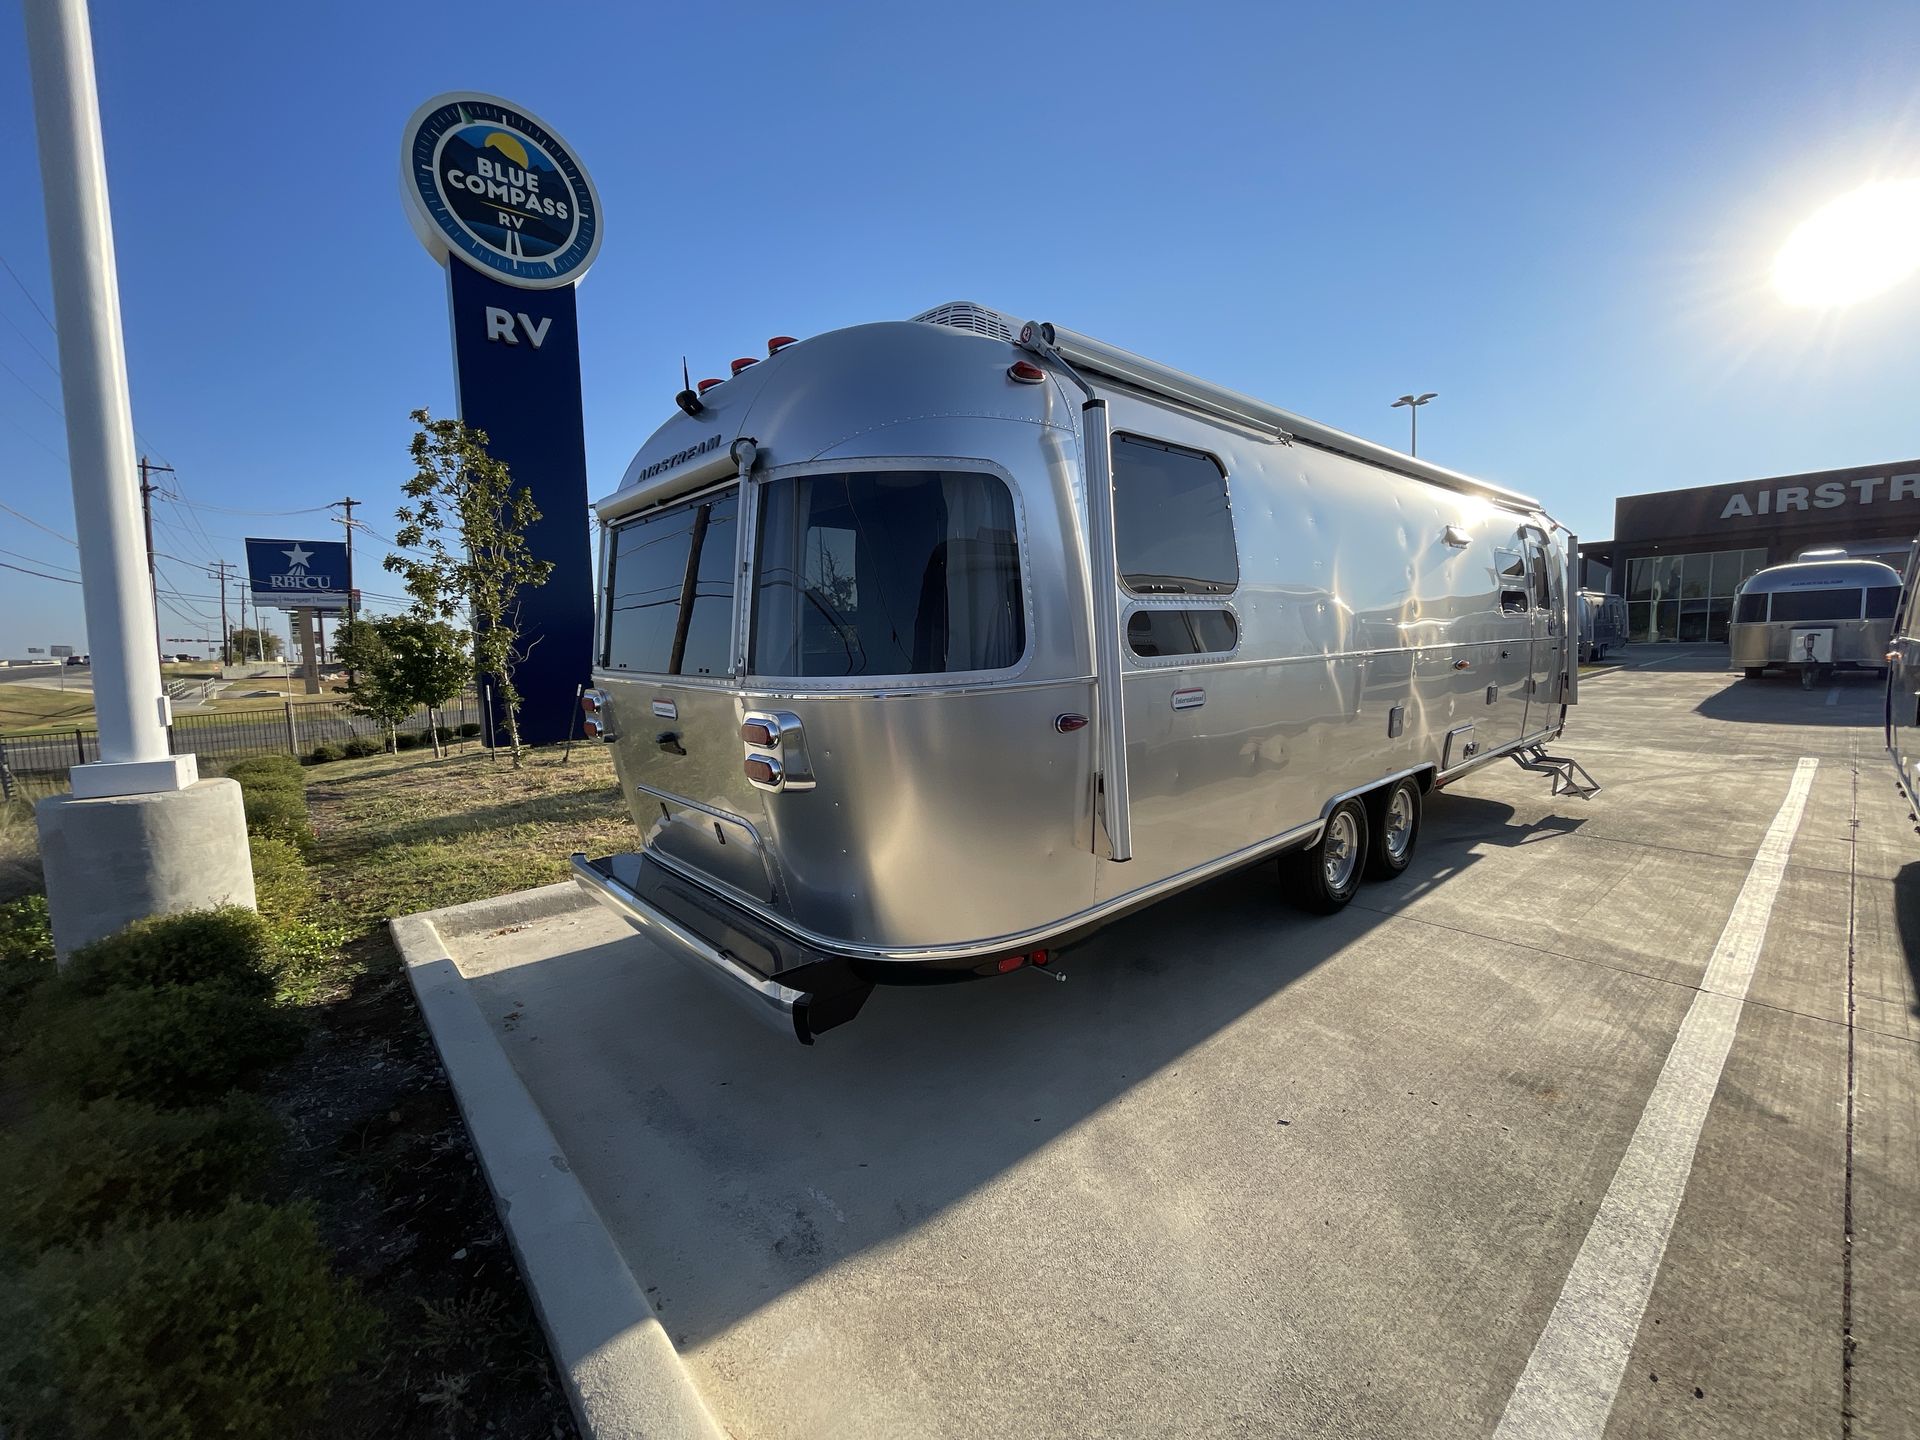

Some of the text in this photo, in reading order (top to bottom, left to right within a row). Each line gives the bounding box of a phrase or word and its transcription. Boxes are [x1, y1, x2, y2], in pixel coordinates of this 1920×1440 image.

[447, 169, 568, 220] COMPASS
[477, 156, 540, 193] BLUE
[498, 211, 525, 230] RV
[485, 305, 553, 350] RV
[638, 434, 722, 481] AIRSTREAM
[1719, 473, 1920, 519] AIRSTR
[270, 575, 331, 589] RBFCU
